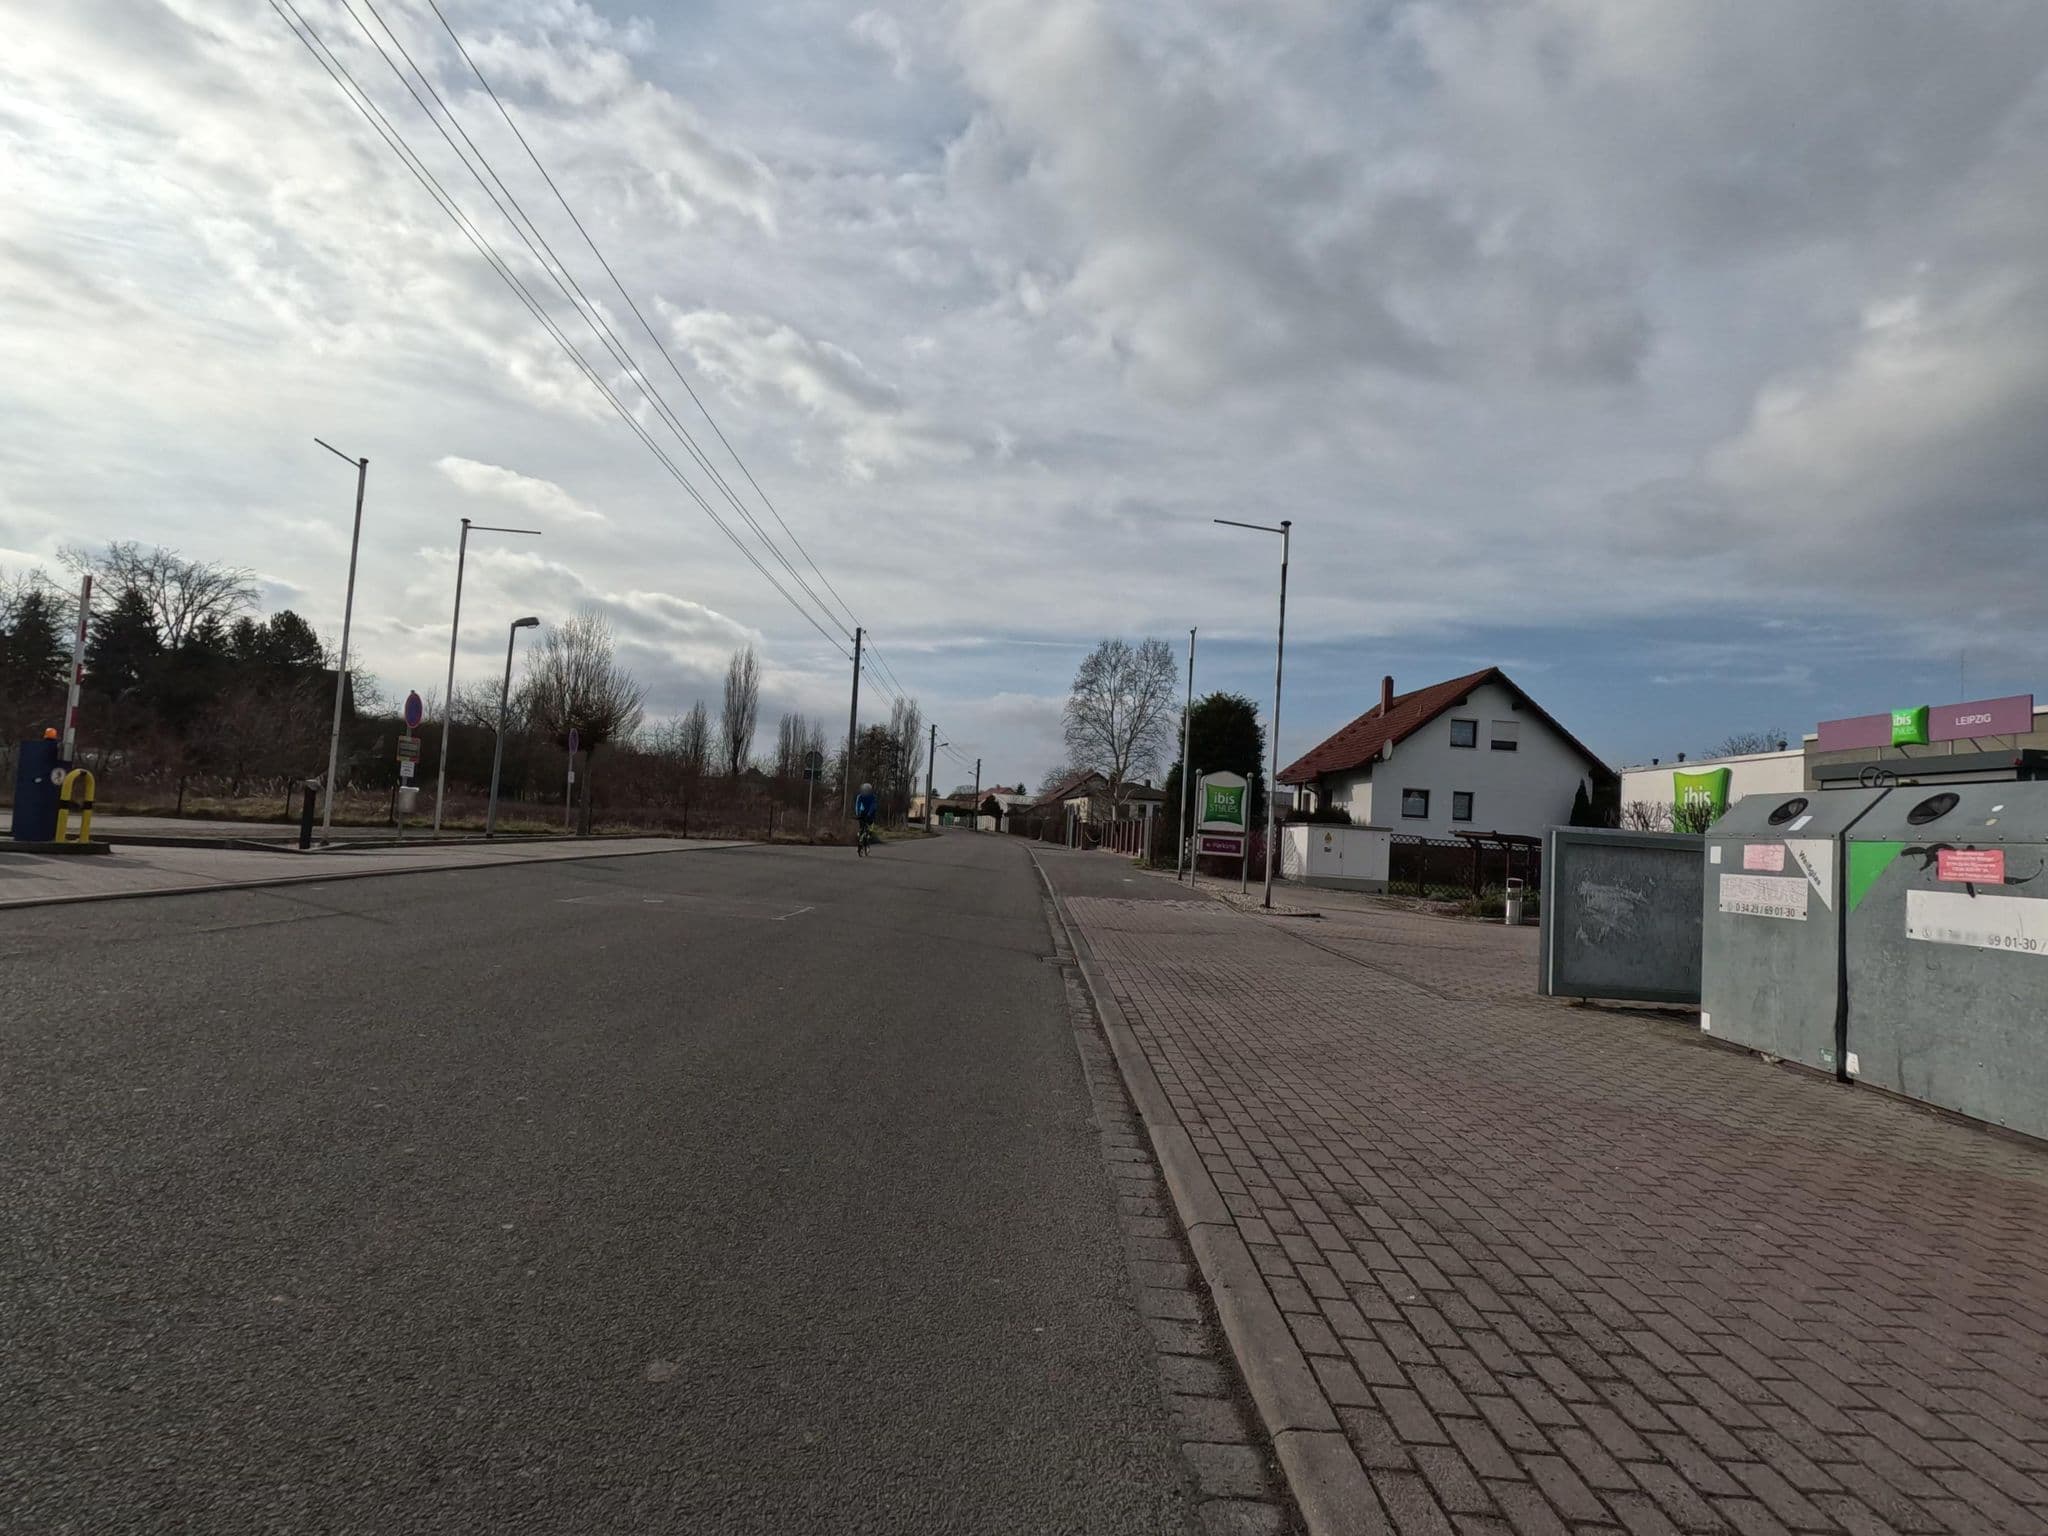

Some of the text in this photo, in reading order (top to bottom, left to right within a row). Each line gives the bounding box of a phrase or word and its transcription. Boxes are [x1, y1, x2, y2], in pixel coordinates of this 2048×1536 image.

[1893, 714, 1912, 726] ibis
[1955, 713, 1992, 726] LEIPZIG
[1214, 791, 1236, 804] ibis
[1735, 903, 1740, 911] 0
[1741, 903, 1749, 912] 34
[1764, 906, 1773, 915] 69
[1774, 906, 1796, 918] 01-30
[2004, 936, 2037, 950] 01-30
